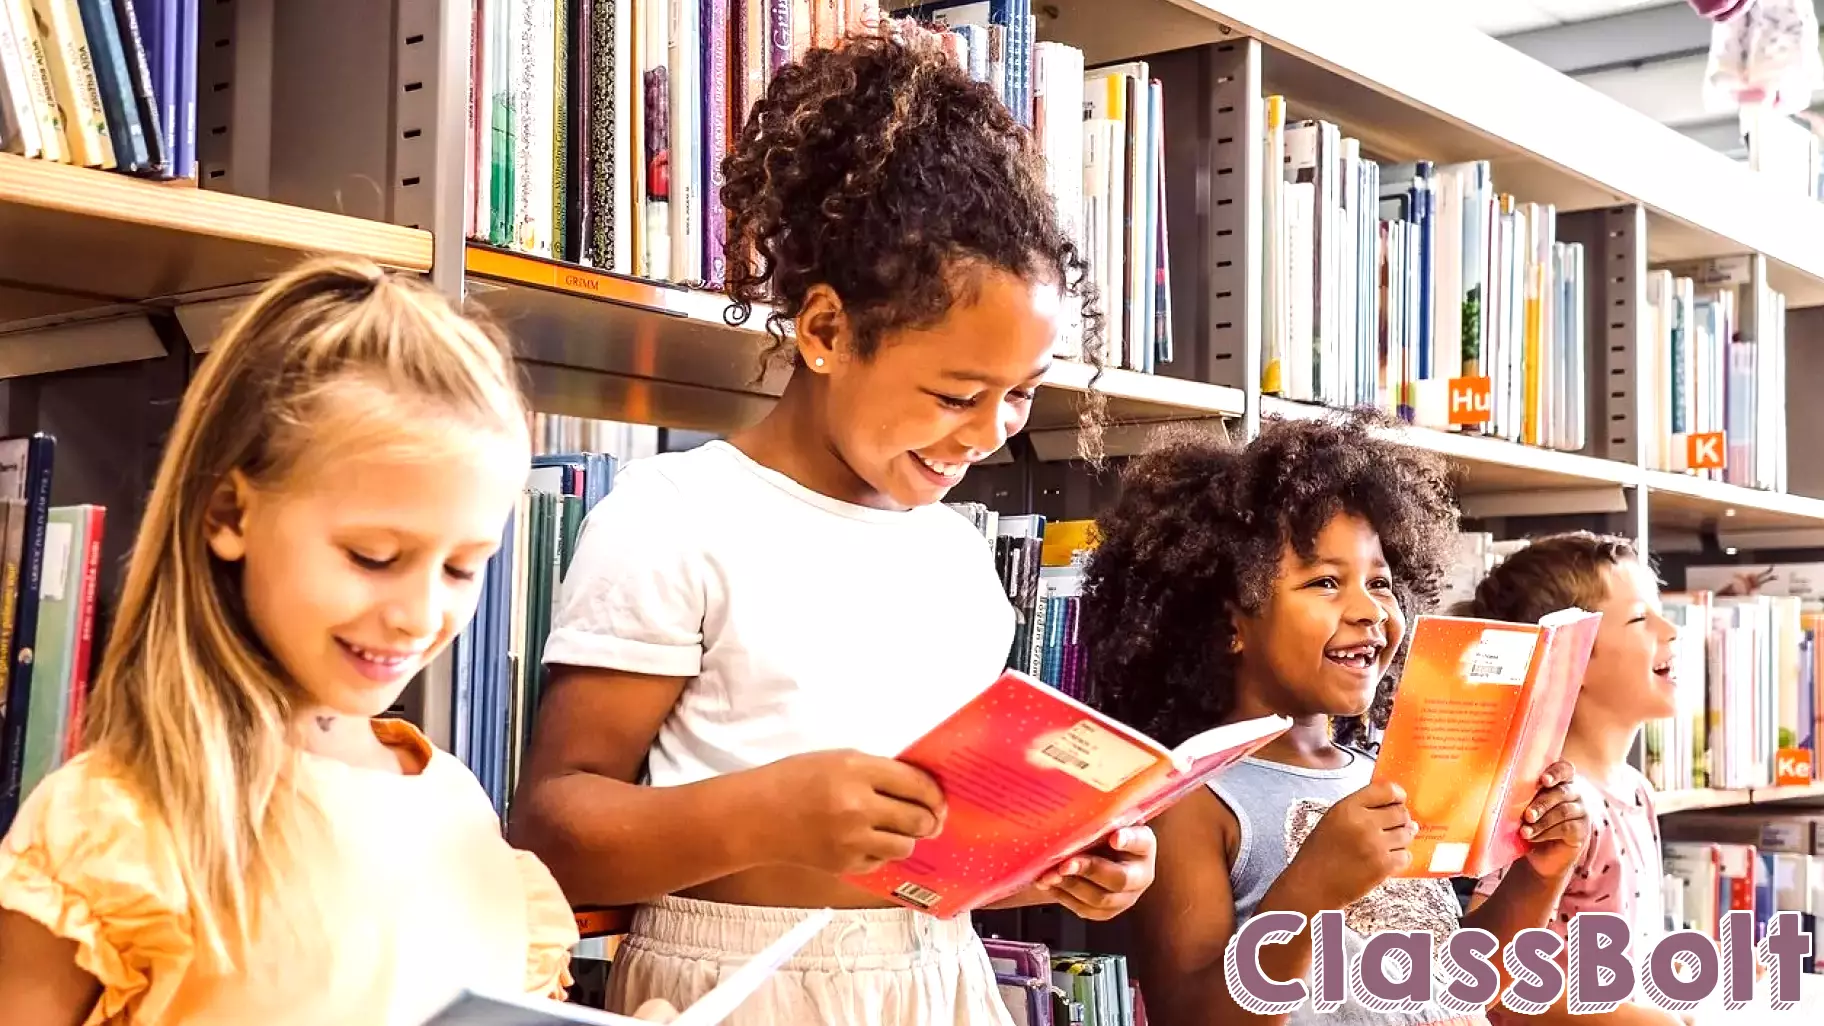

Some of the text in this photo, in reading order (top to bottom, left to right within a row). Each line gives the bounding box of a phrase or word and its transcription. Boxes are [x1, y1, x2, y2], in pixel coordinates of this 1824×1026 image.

[565, 275, 599, 291] GRIMM
[1452, 387, 1491, 413] Hu
[1695, 436, 1720, 464] K
[1779, 757, 1811, 777] Ke
